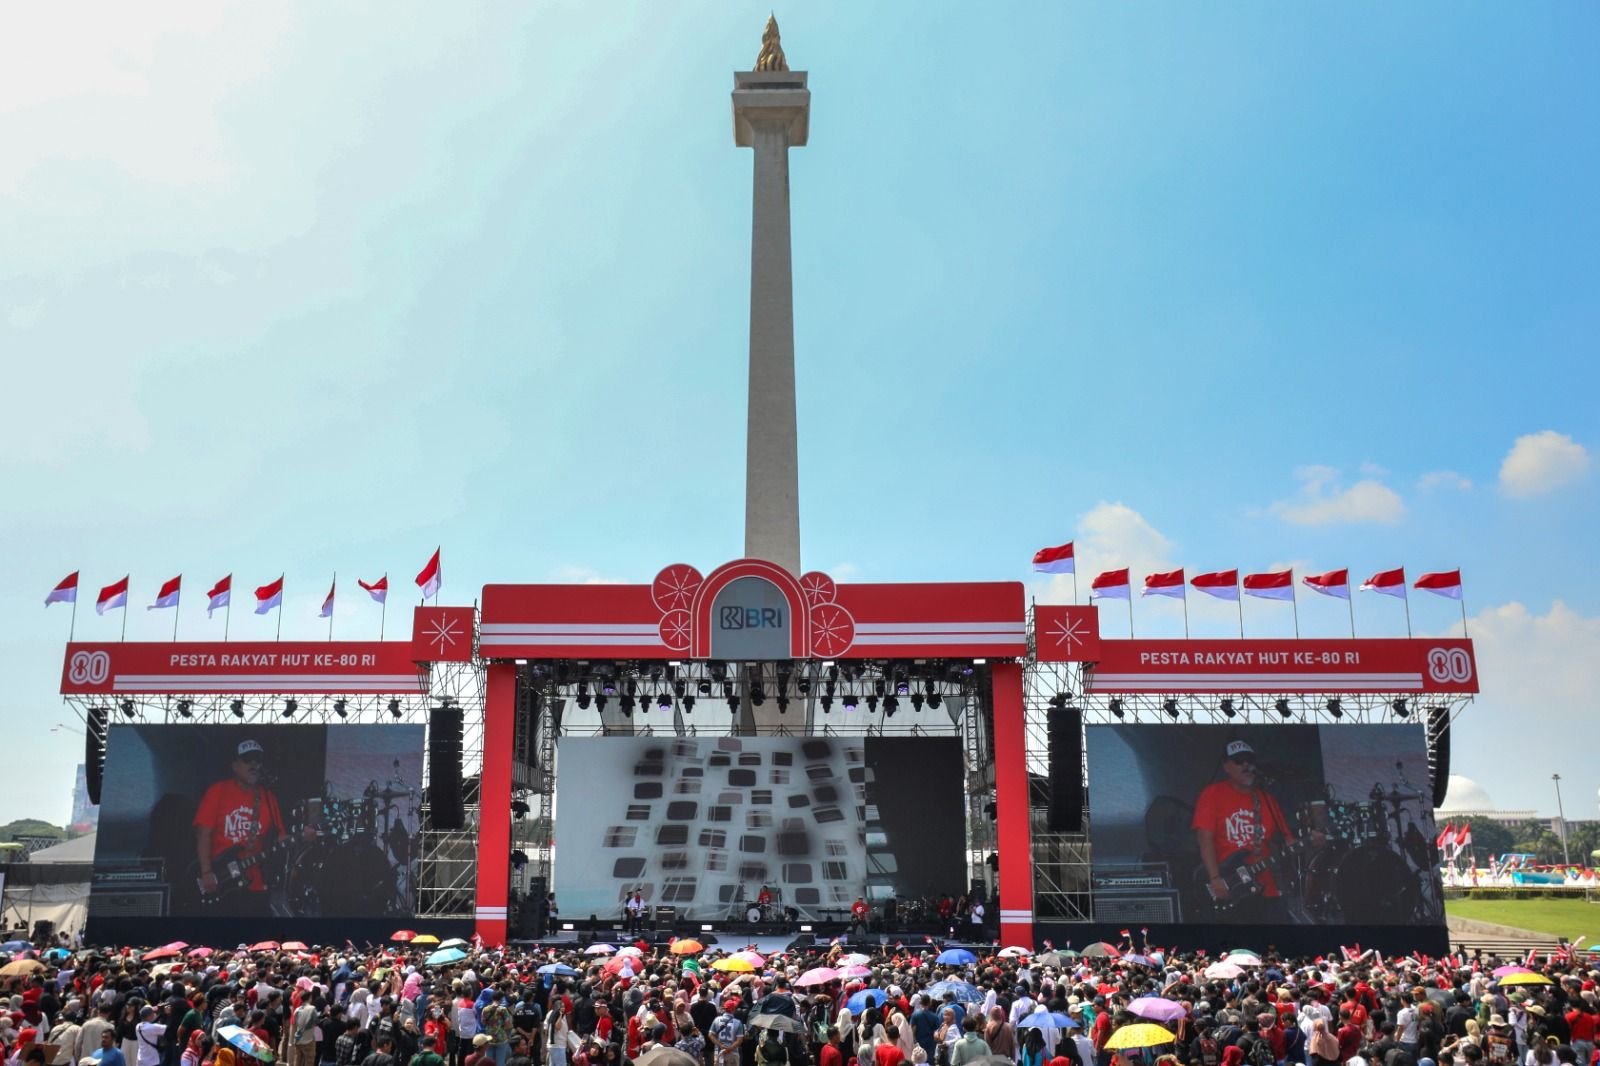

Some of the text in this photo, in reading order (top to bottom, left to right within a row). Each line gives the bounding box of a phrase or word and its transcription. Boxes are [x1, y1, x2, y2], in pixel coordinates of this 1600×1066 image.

[745, 607, 782, 628] BRI
[69, 650, 110, 685] 80
[170, 654, 376, 666] PESTA RAKYAT HUT KE-80 RI
[1140, 652, 1360, 665] PESTA RAKYAT HUT KE-80 RI
[1427, 647, 1472, 683] 80
